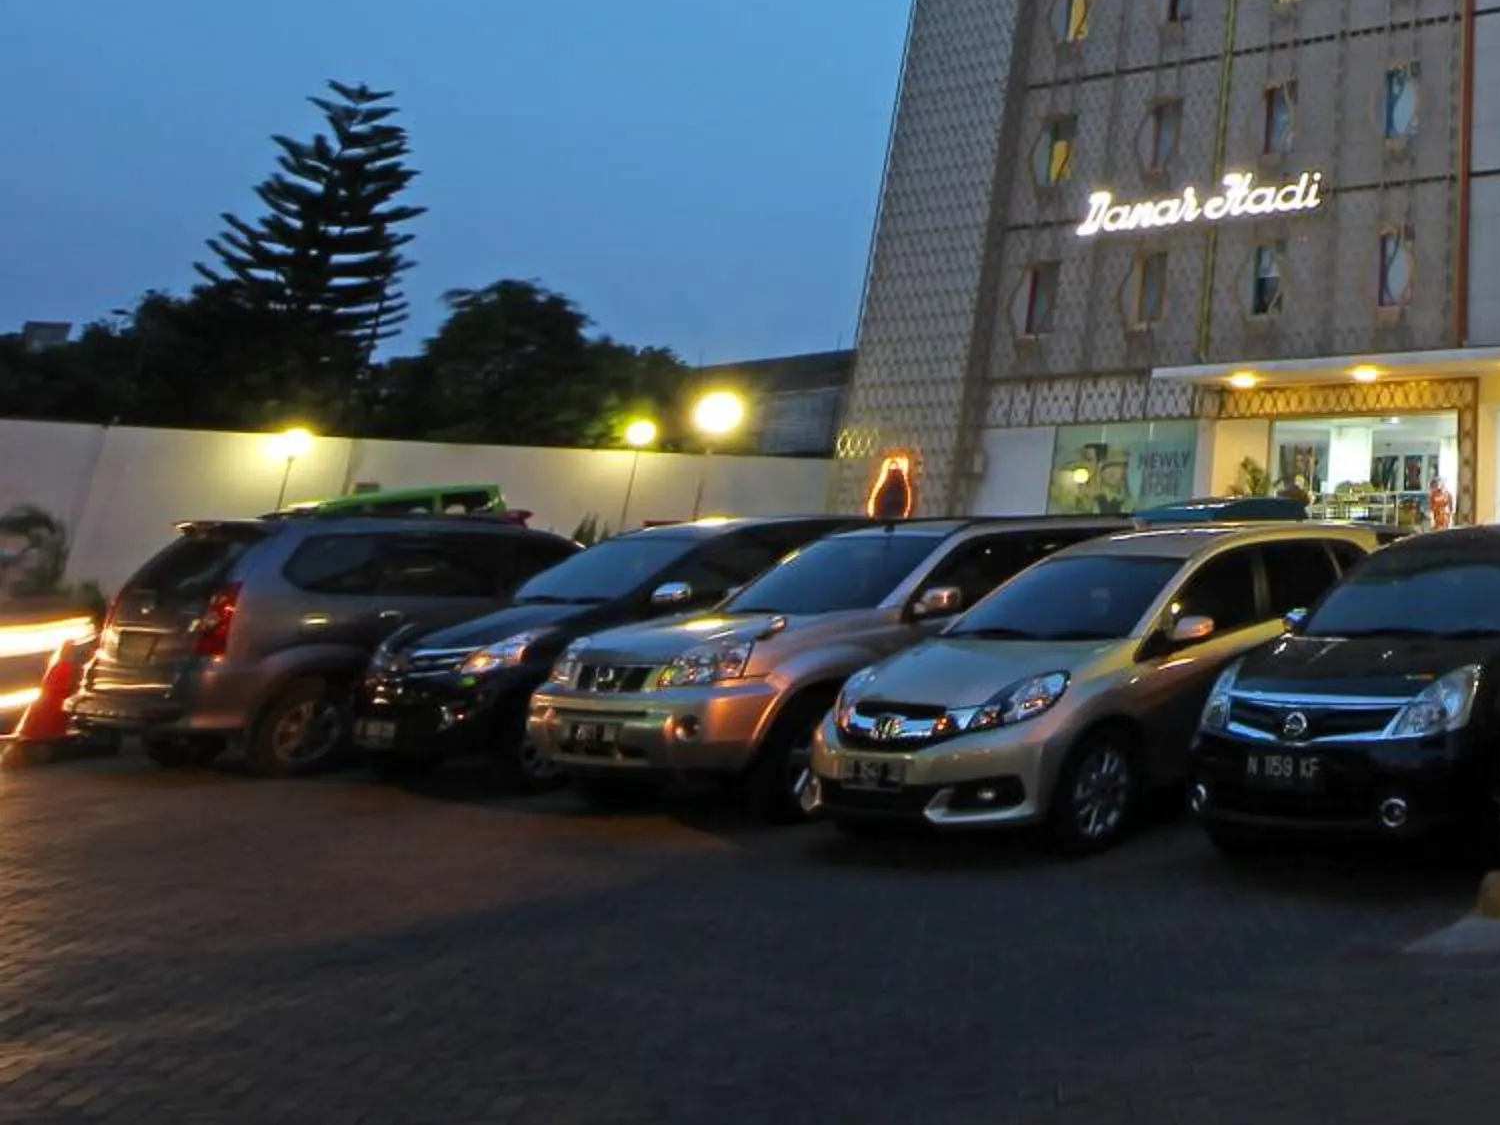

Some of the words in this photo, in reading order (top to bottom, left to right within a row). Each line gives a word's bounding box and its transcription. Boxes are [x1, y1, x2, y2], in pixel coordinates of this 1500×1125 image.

[1076, 186, 1201, 236] Danar
[1203, 172, 1323, 220] Hadi
[1137, 451, 1191, 470] NEWLY
[1247, 755, 1258, 775] N
